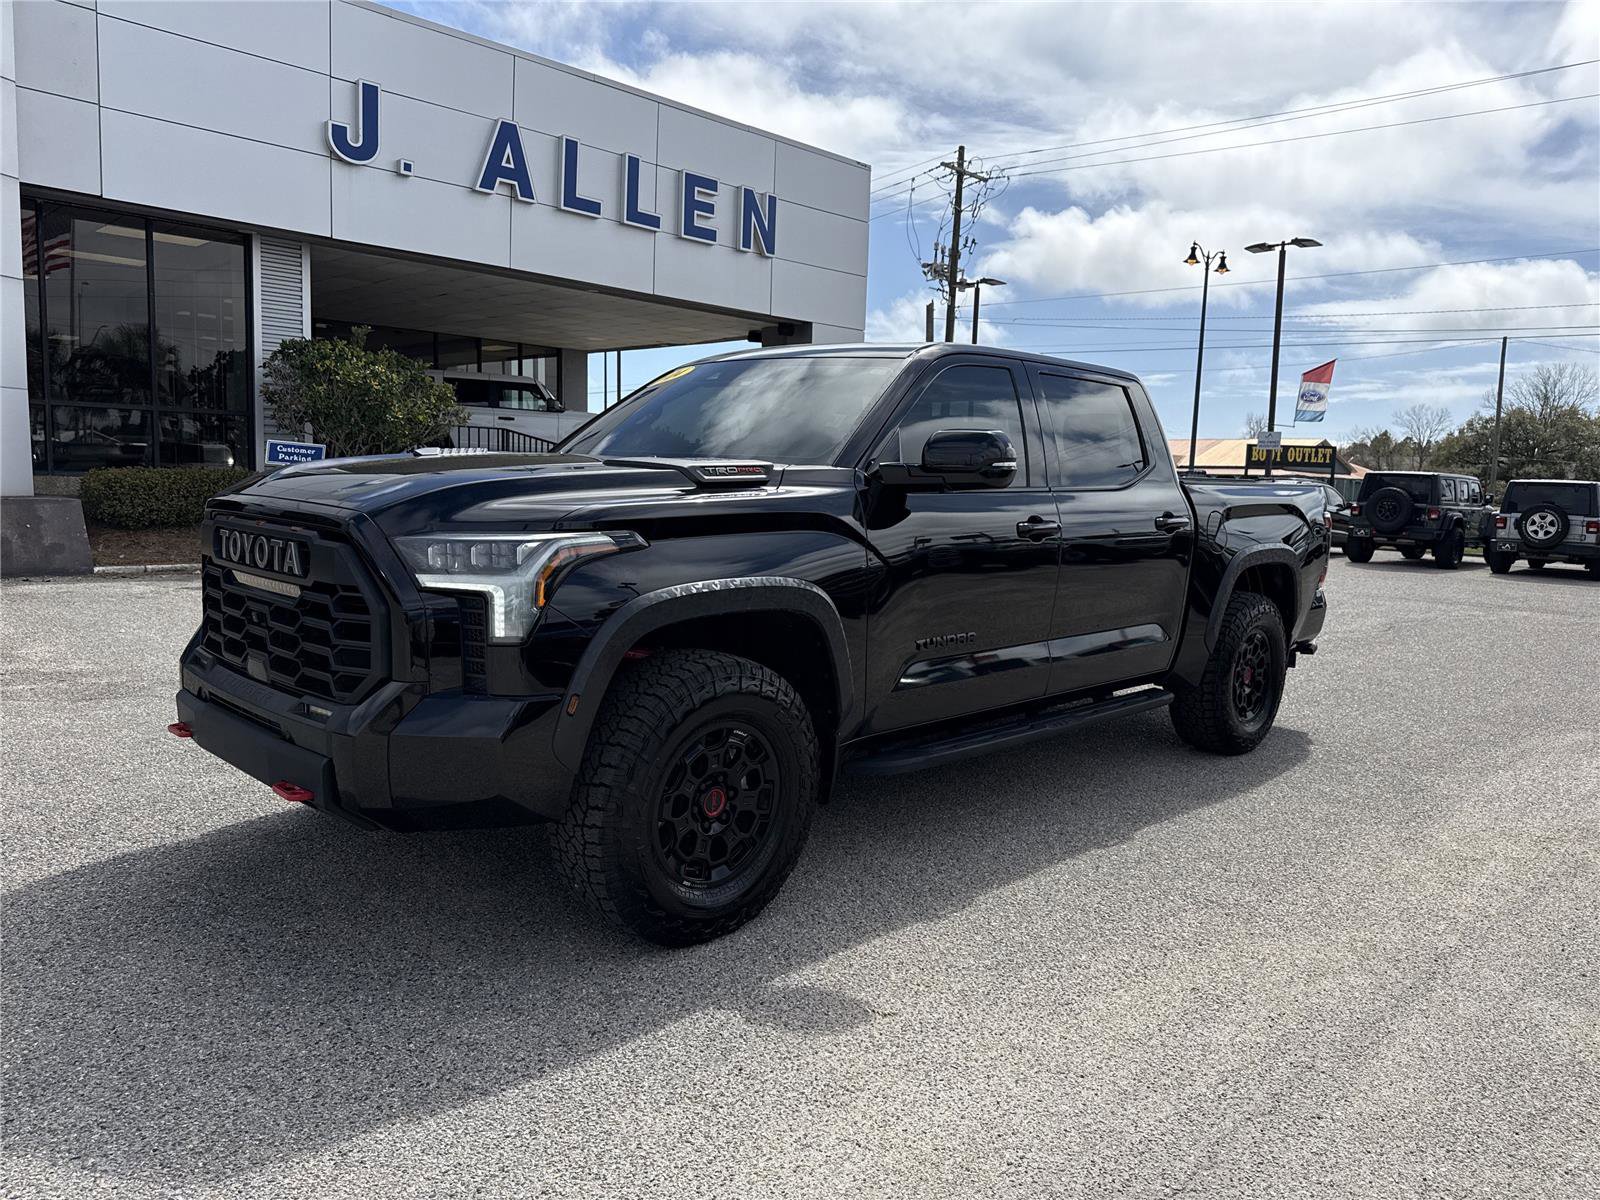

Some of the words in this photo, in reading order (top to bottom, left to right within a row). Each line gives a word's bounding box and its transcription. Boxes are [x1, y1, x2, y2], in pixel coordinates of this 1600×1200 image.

[327, 78, 414, 177] J.
[472, 118, 778, 258] ALLEN
[277, 445, 316, 455] Customer
[1287, 447, 1333, 463] OUTLET
[219, 529, 302, 576] TOYOTA
[914, 631, 977, 650] TUNDRA
